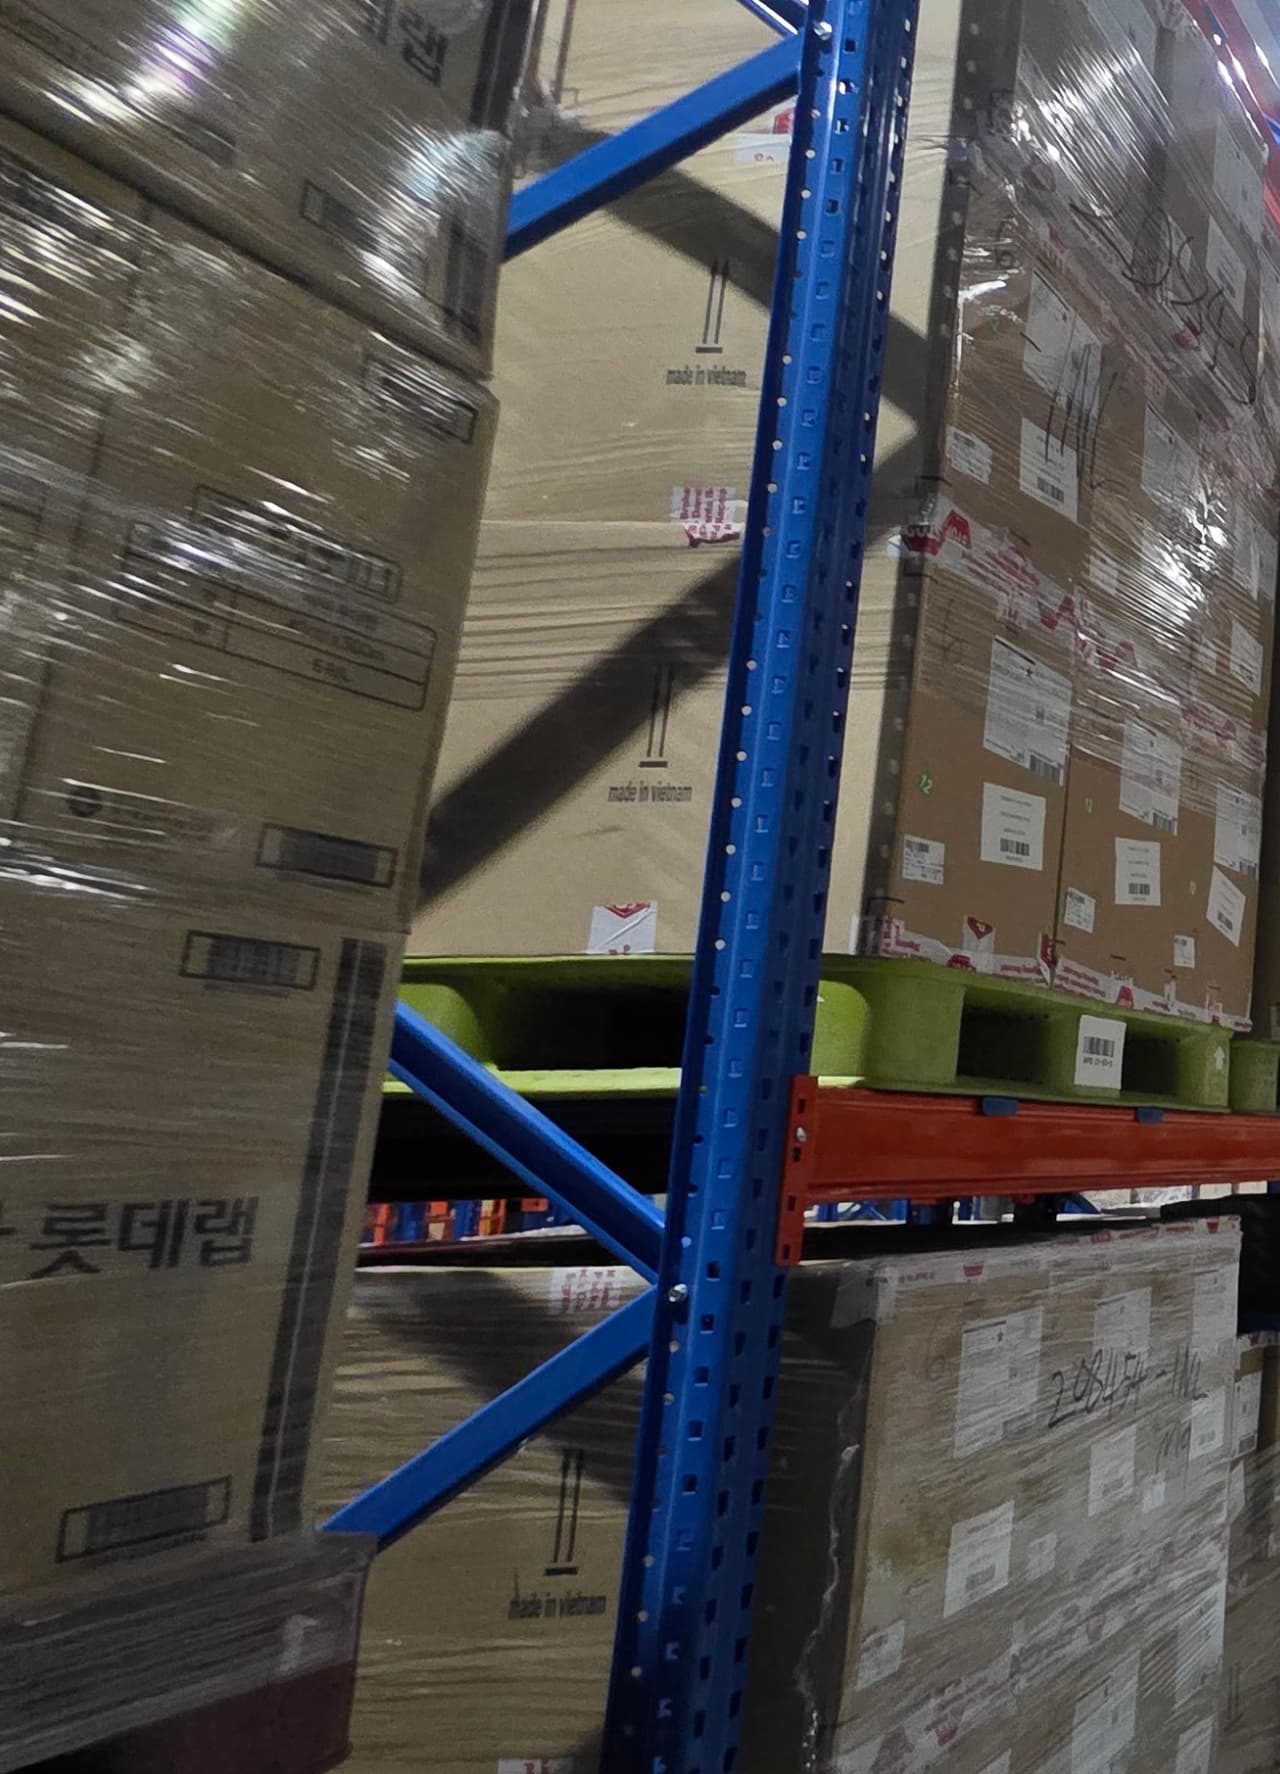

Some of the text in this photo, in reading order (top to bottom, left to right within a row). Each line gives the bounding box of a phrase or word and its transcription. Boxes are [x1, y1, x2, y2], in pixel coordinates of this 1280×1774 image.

[666, 365, 746, 387] made in vietnam
[608, 780, 693, 802] made in vietnam
[28, 1196, 259, 1280] 롯데랩
